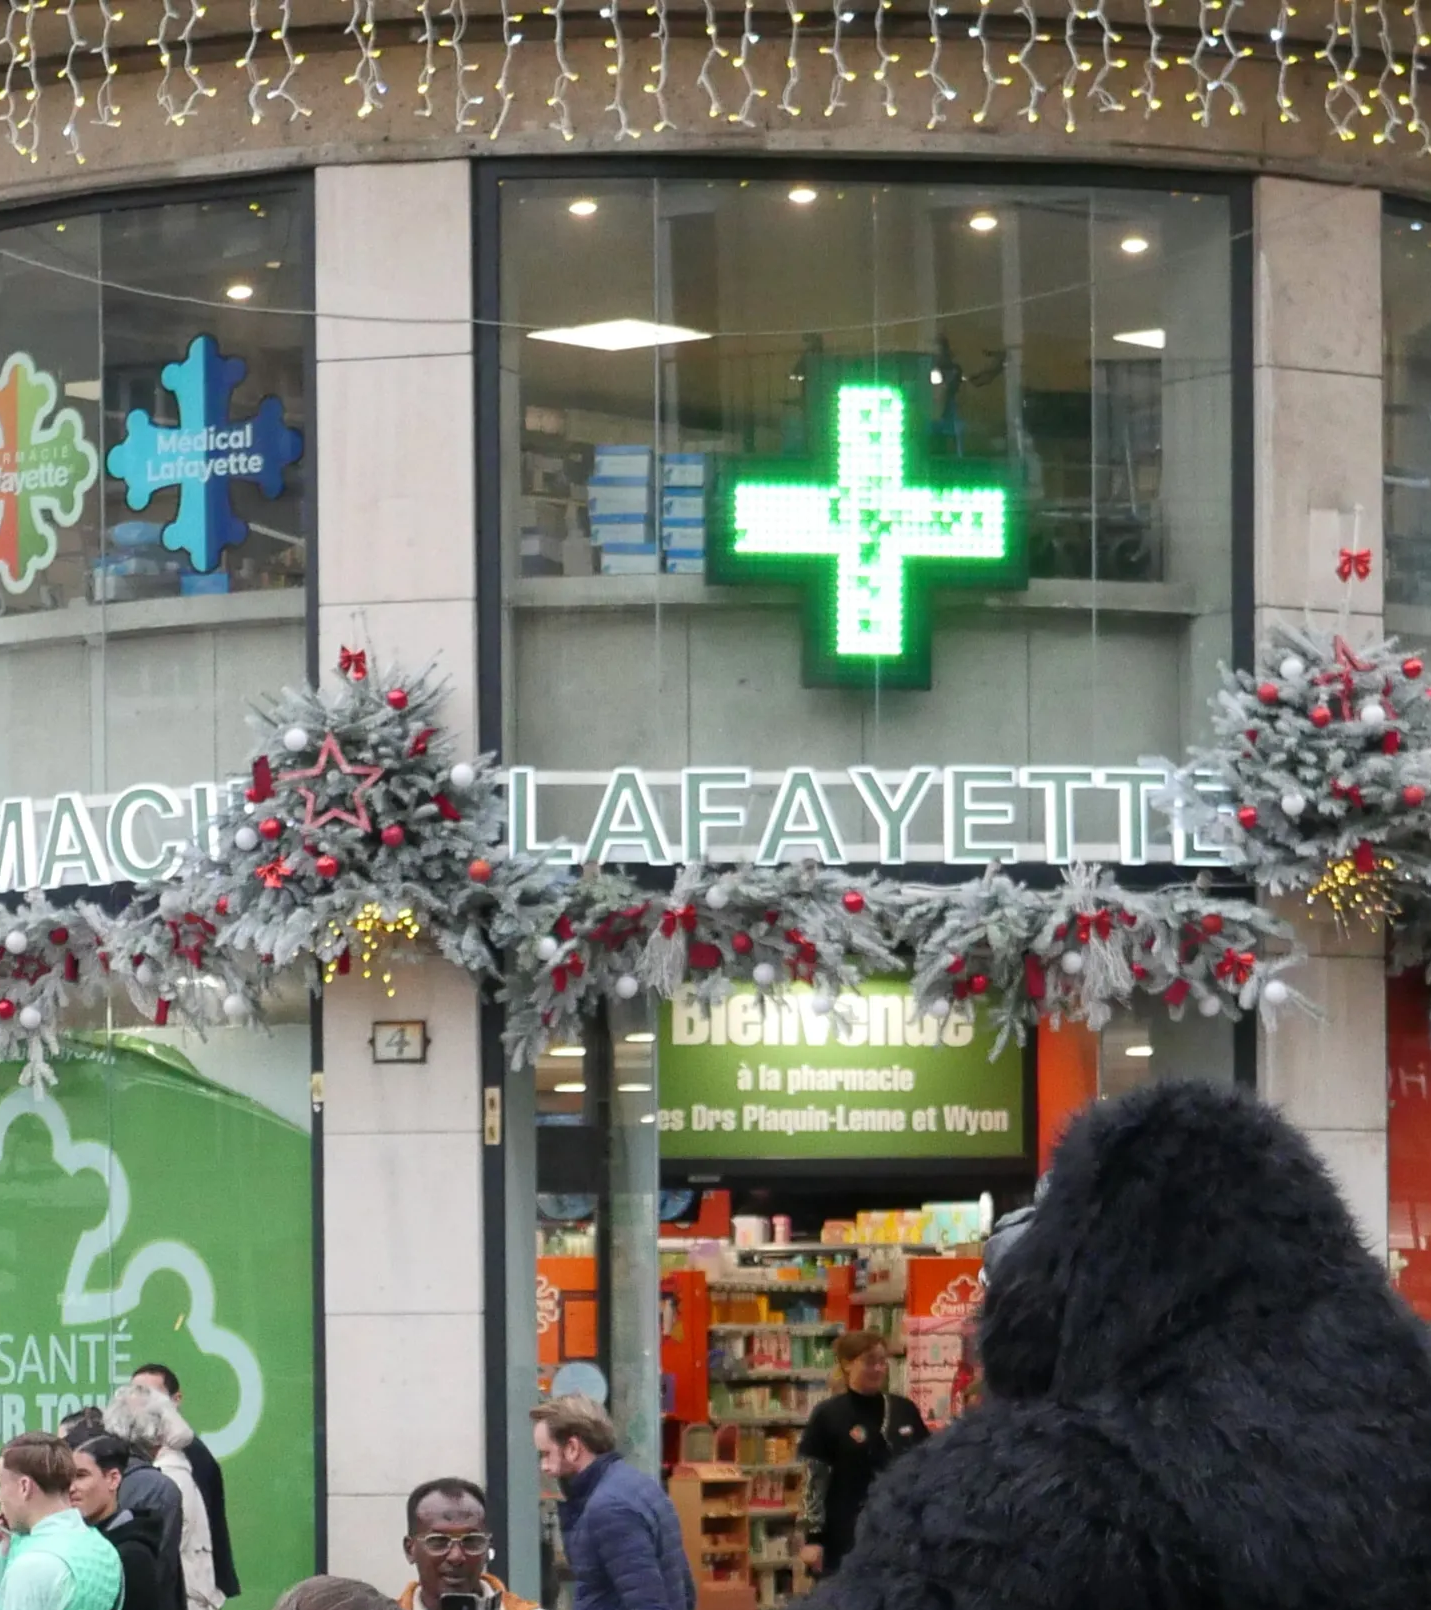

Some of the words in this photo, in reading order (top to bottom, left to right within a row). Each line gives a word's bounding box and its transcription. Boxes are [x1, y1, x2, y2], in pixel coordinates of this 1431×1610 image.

[156, 424, 253, 454] Médical
[146, 447, 264, 483] Lafayette
[385, 1027, 411, 1057] 4
[737, 1062, 754, 1091] à
[759, 1063, 781, 1091] la
[787, 1064, 914, 1095] pharmacie
[657, 1110, 685, 1133] es
[691, 1105, 736, 1132] Drs
[743, 1103, 905, 1136] Plaquin-Lenne
[912, 1107, 938, 1132] et
[944, 1106, 1010, 1136] Wyon
